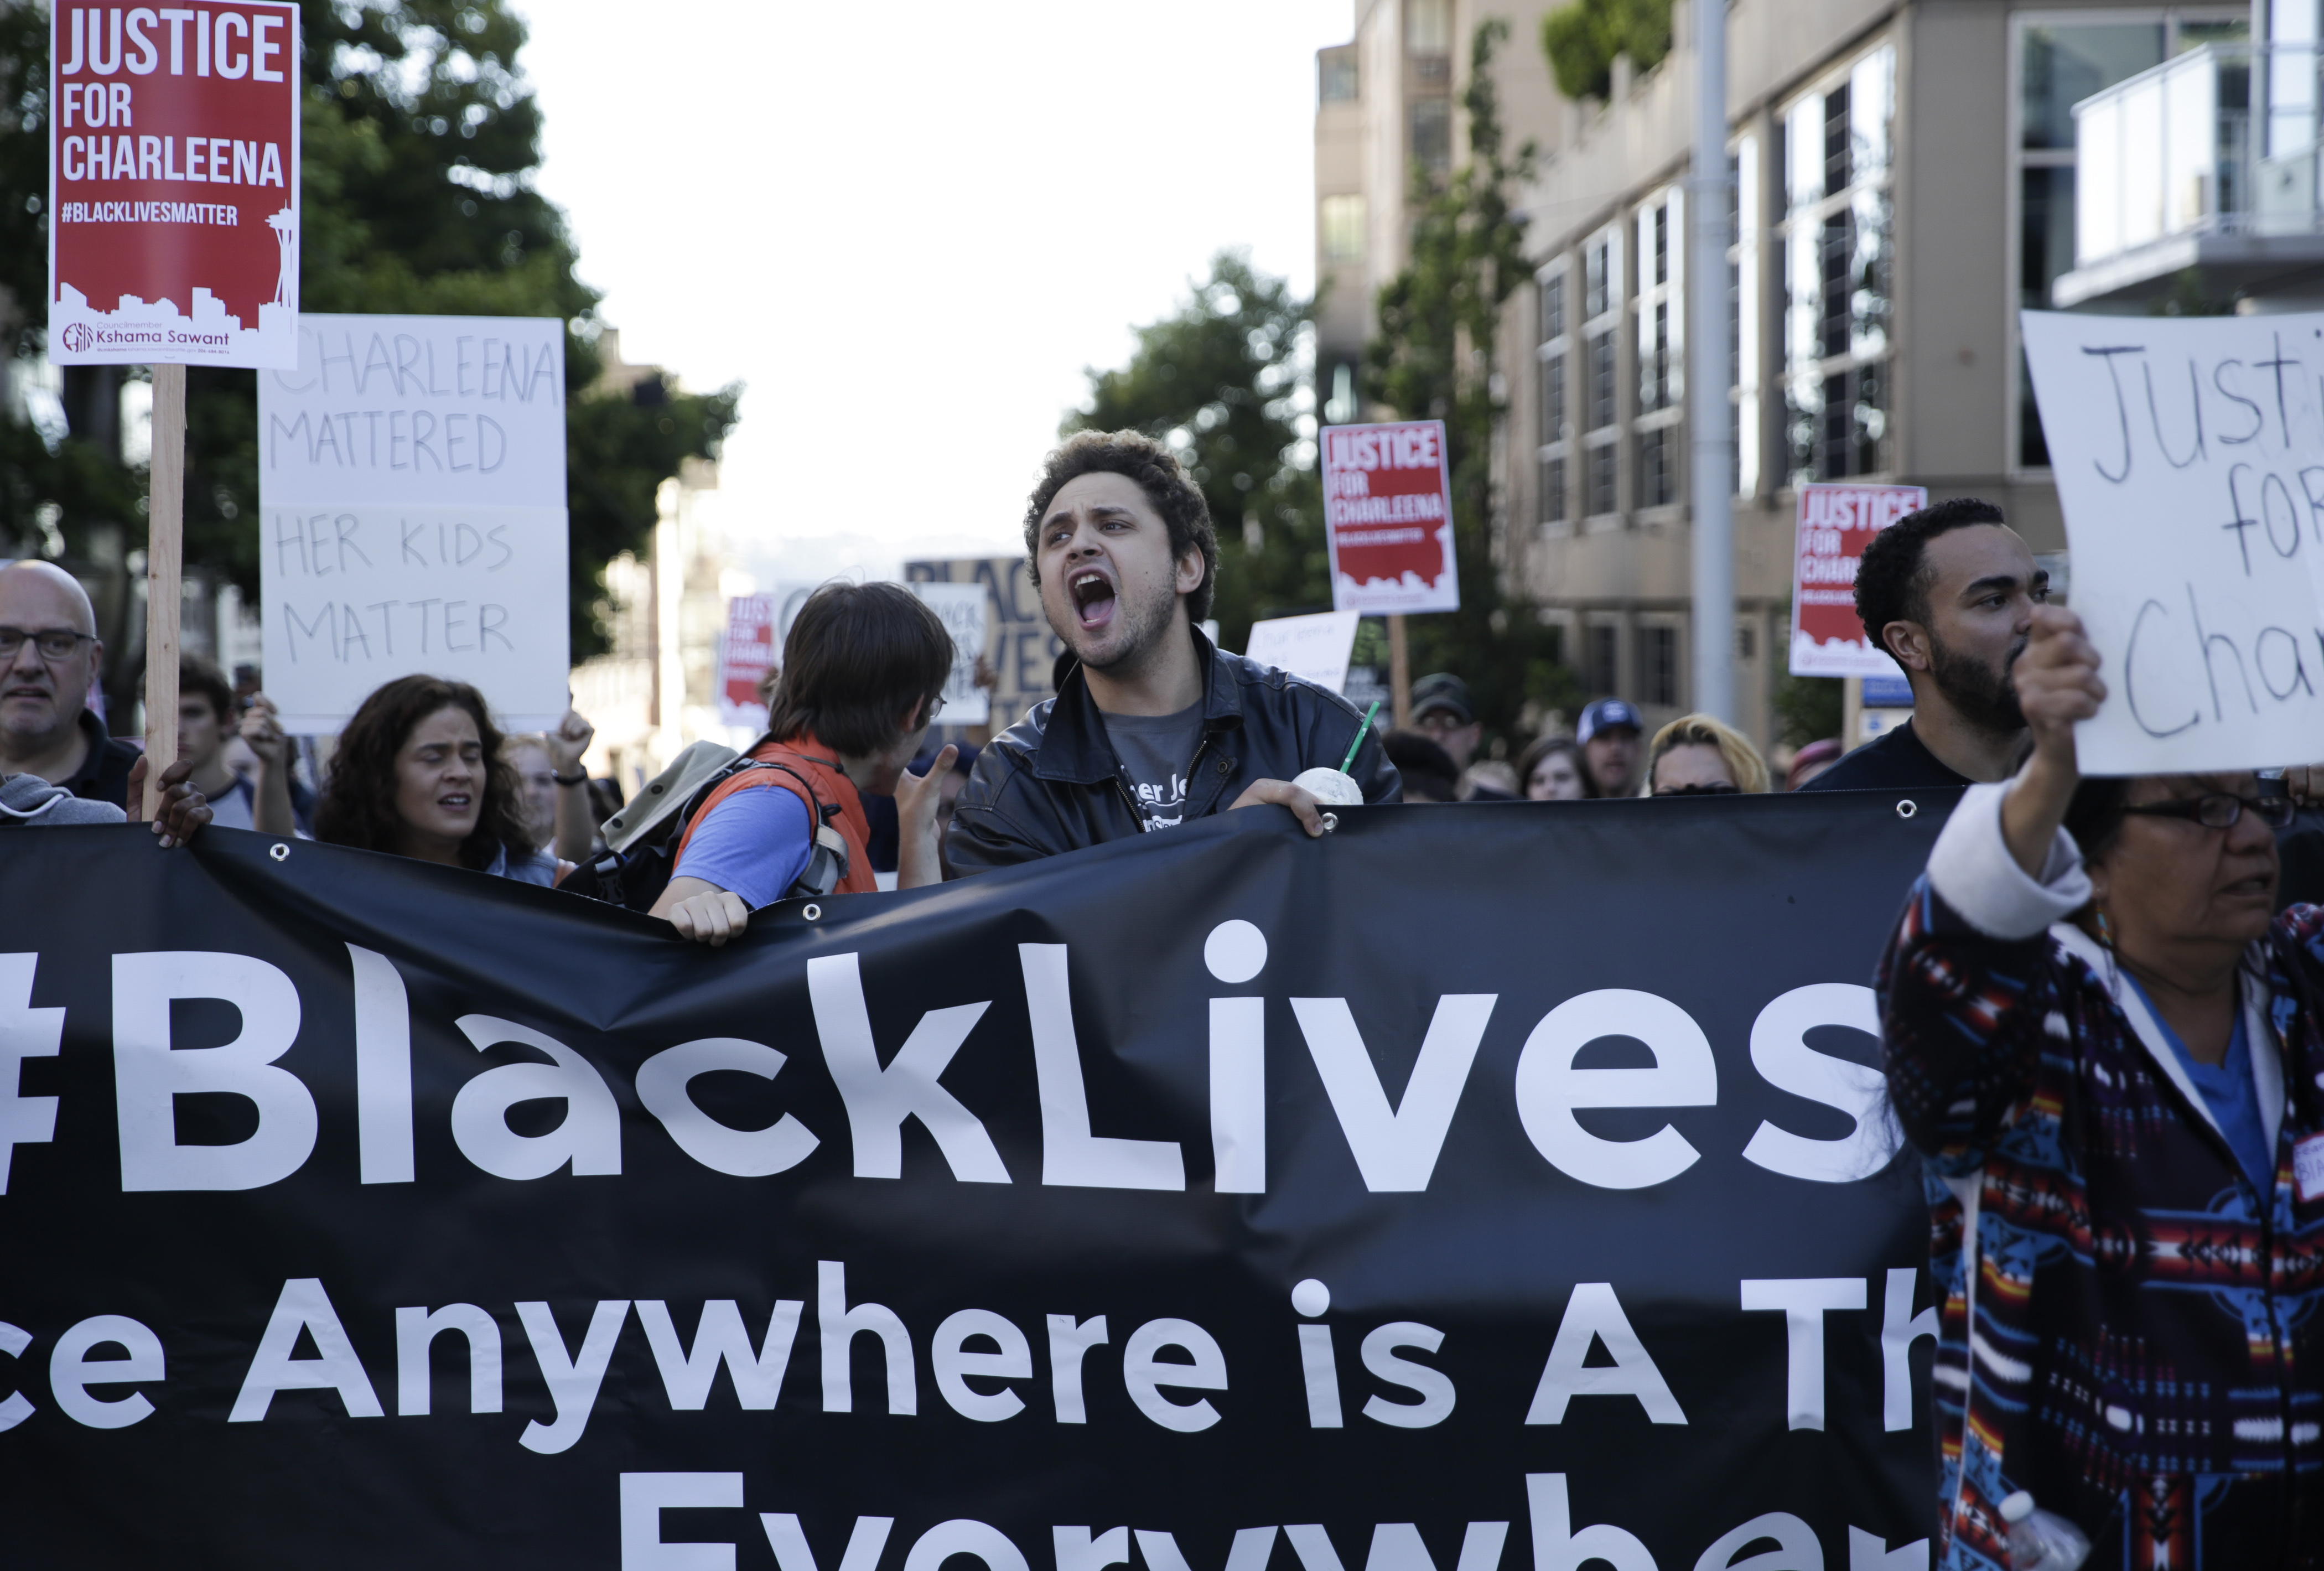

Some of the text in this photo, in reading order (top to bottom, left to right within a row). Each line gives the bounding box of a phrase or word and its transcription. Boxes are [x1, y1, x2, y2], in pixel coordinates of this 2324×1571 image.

[61, 7, 283, 82] JUSTICE
[63, 82, 132, 128] FOR
[62, 135, 284, 188] CHARLEENA
[61, 201, 238, 226] #BLACKLIVESMATTER
[96, 321, 163, 329] Councilmember
[97, 330, 229, 345] Kshama Sawant
[270, 409, 507, 474] MATTERED
[1330, 427, 1439, 471] JUSTICE
[1331, 470, 1369, 496] FOR
[1331, 492, 1444, 526] CHARLEENA
[1801, 489, 1919, 531] JUSTICE
[274, 513, 513, 578] HER KIDS
[1801, 528, 1842, 555] FOR
[283, 598, 515, 664] MATTER
[227, 1260, 1228, 1455] Anywhere
[1291, 1278, 1456, 1429] is
[1524, 1283, 1689, 1425] A
[1740, 1267, 1941, 1432] Th
[619, 1472, 1930, 1571] Evehe
